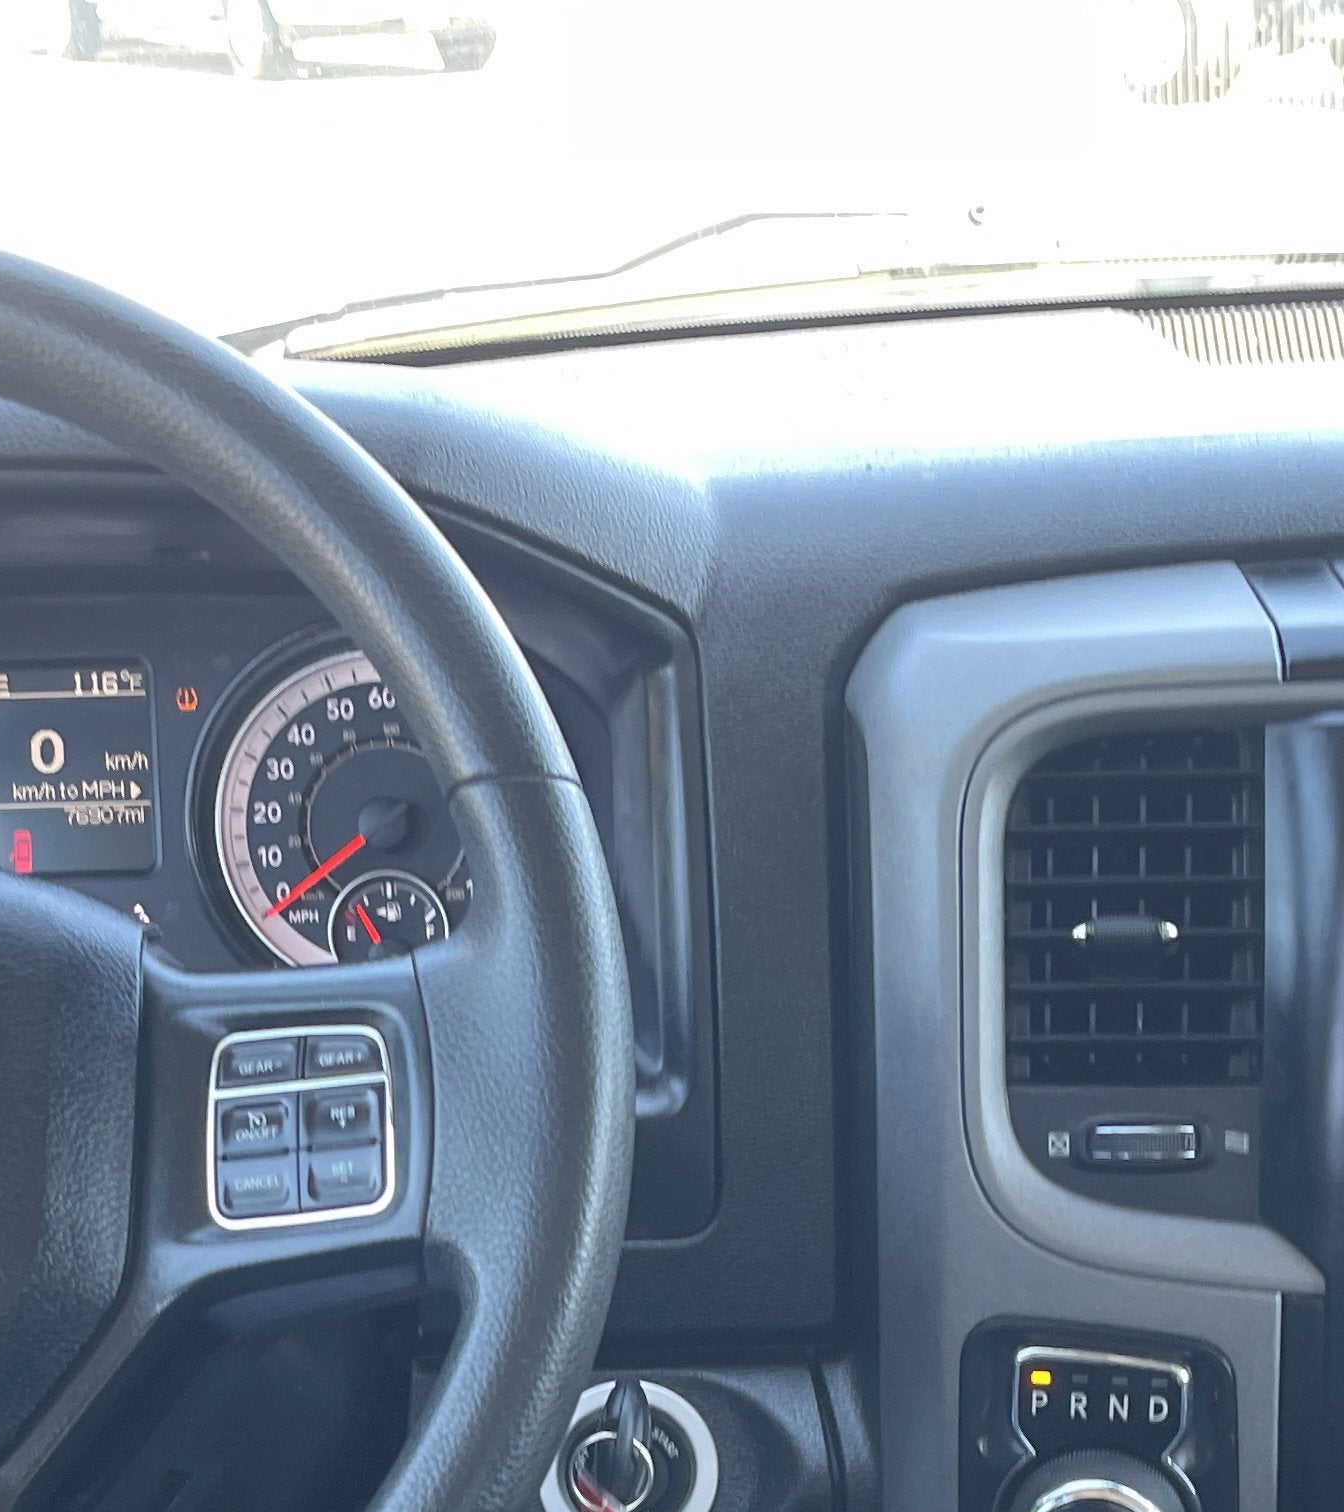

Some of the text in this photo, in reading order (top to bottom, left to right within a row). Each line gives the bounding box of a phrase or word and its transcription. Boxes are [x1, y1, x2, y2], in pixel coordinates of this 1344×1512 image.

[326, 697, 355, 721] 50
[368, 686, 396, 710] 60
[287, 722, 316, 746] 40
[30, 728, 65, 775] 0
[105, 751, 149, 772] km/h
[266, 757, 295, 781] 30
[12, 779, 125, 802] km/h to MPH
[253, 801, 282, 825] 20
[257, 844, 283, 869] 10
[276, 881, 292, 904] 0
[288, 908, 319, 925] MPH
[1031, 1388, 1169, 1423] P R N D
